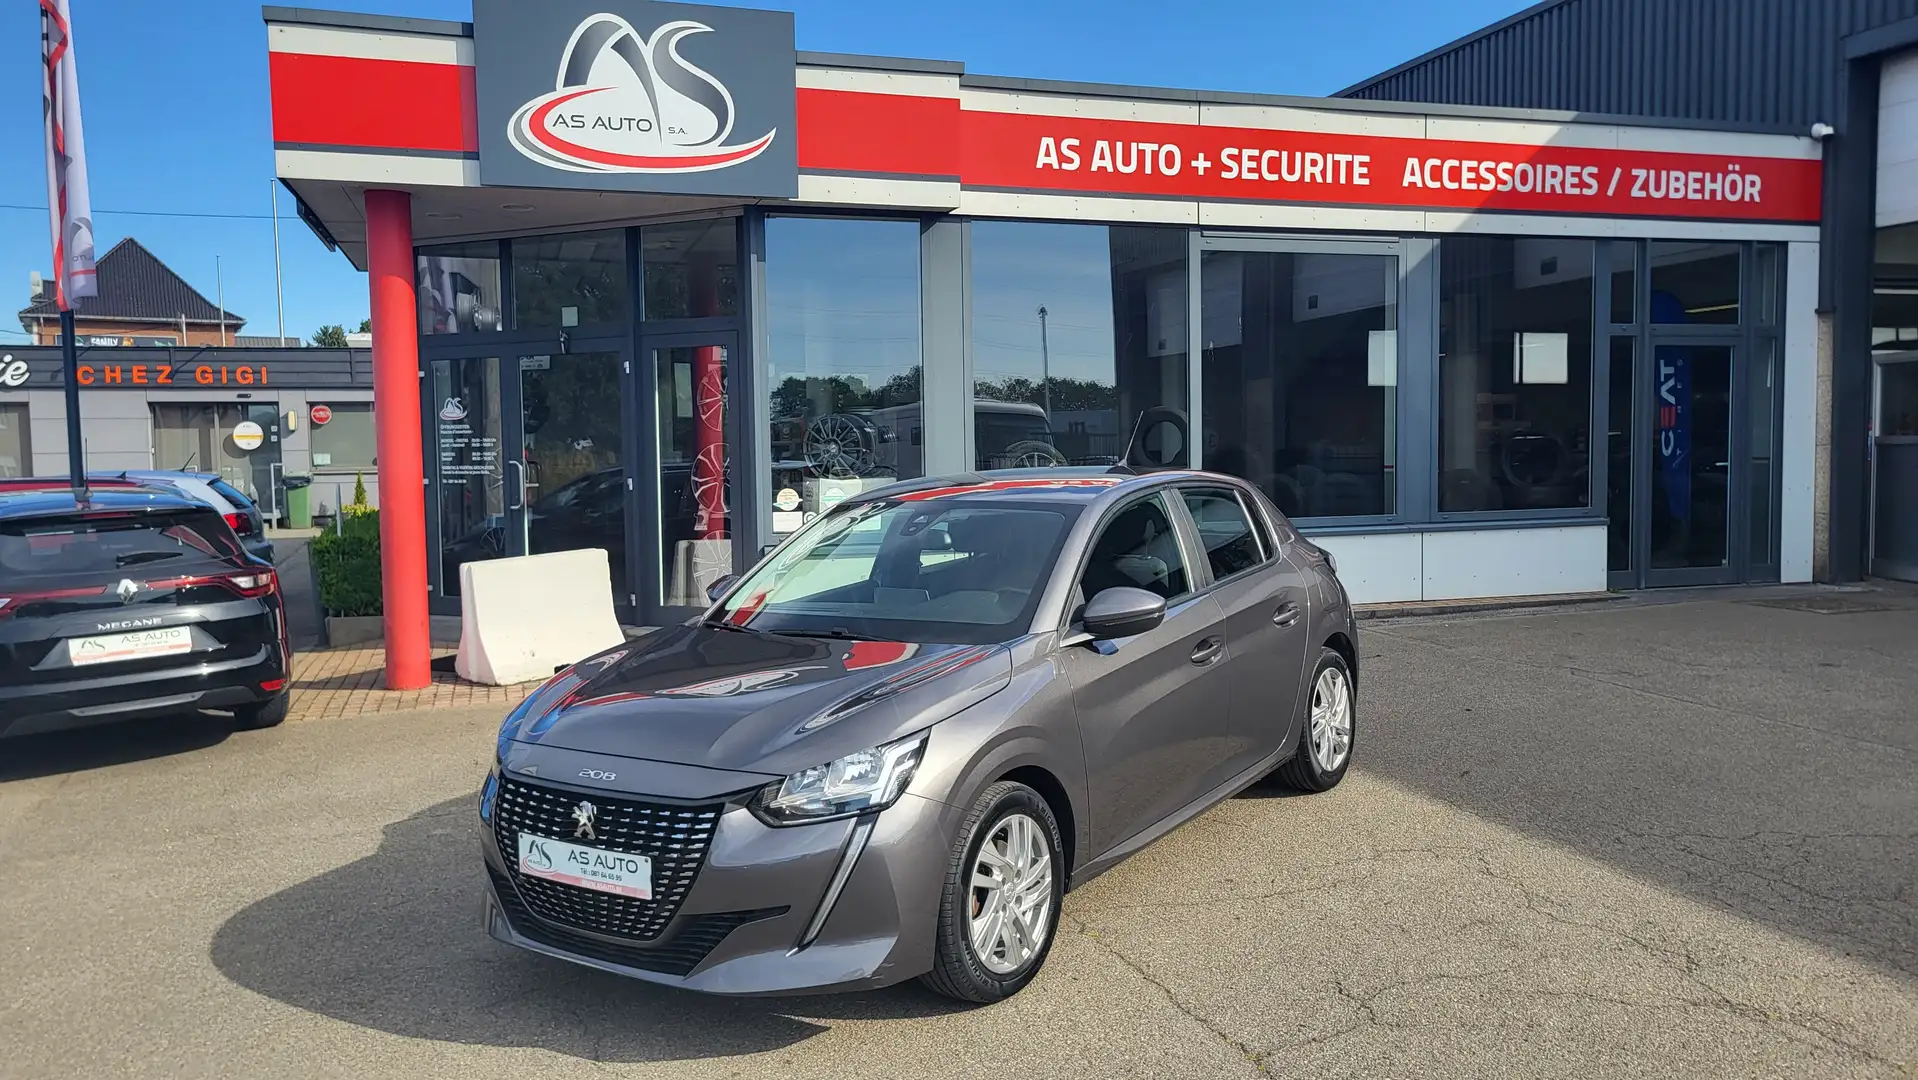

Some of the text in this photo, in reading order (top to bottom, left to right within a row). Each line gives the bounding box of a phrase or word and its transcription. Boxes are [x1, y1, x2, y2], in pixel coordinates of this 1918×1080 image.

[552, 113, 688, 135] AS AUTO S.A.
[1035, 136, 1371, 186] AS AUTO + SECURITE
[1401, 156, 1762, 203] ACCESSOIRES / ZUBEHÖR
[76, 364, 269, 385] CHEZ GIGI
[97, 618, 162, 630] MEGANE
[121, 630, 180, 643] AS AUTO
[578, 768, 617, 781] 208
[567, 849, 639, 874] AS AUTO
[591, 869, 600, 877] 087
[964, 943, 990, 986] MICHELIN
